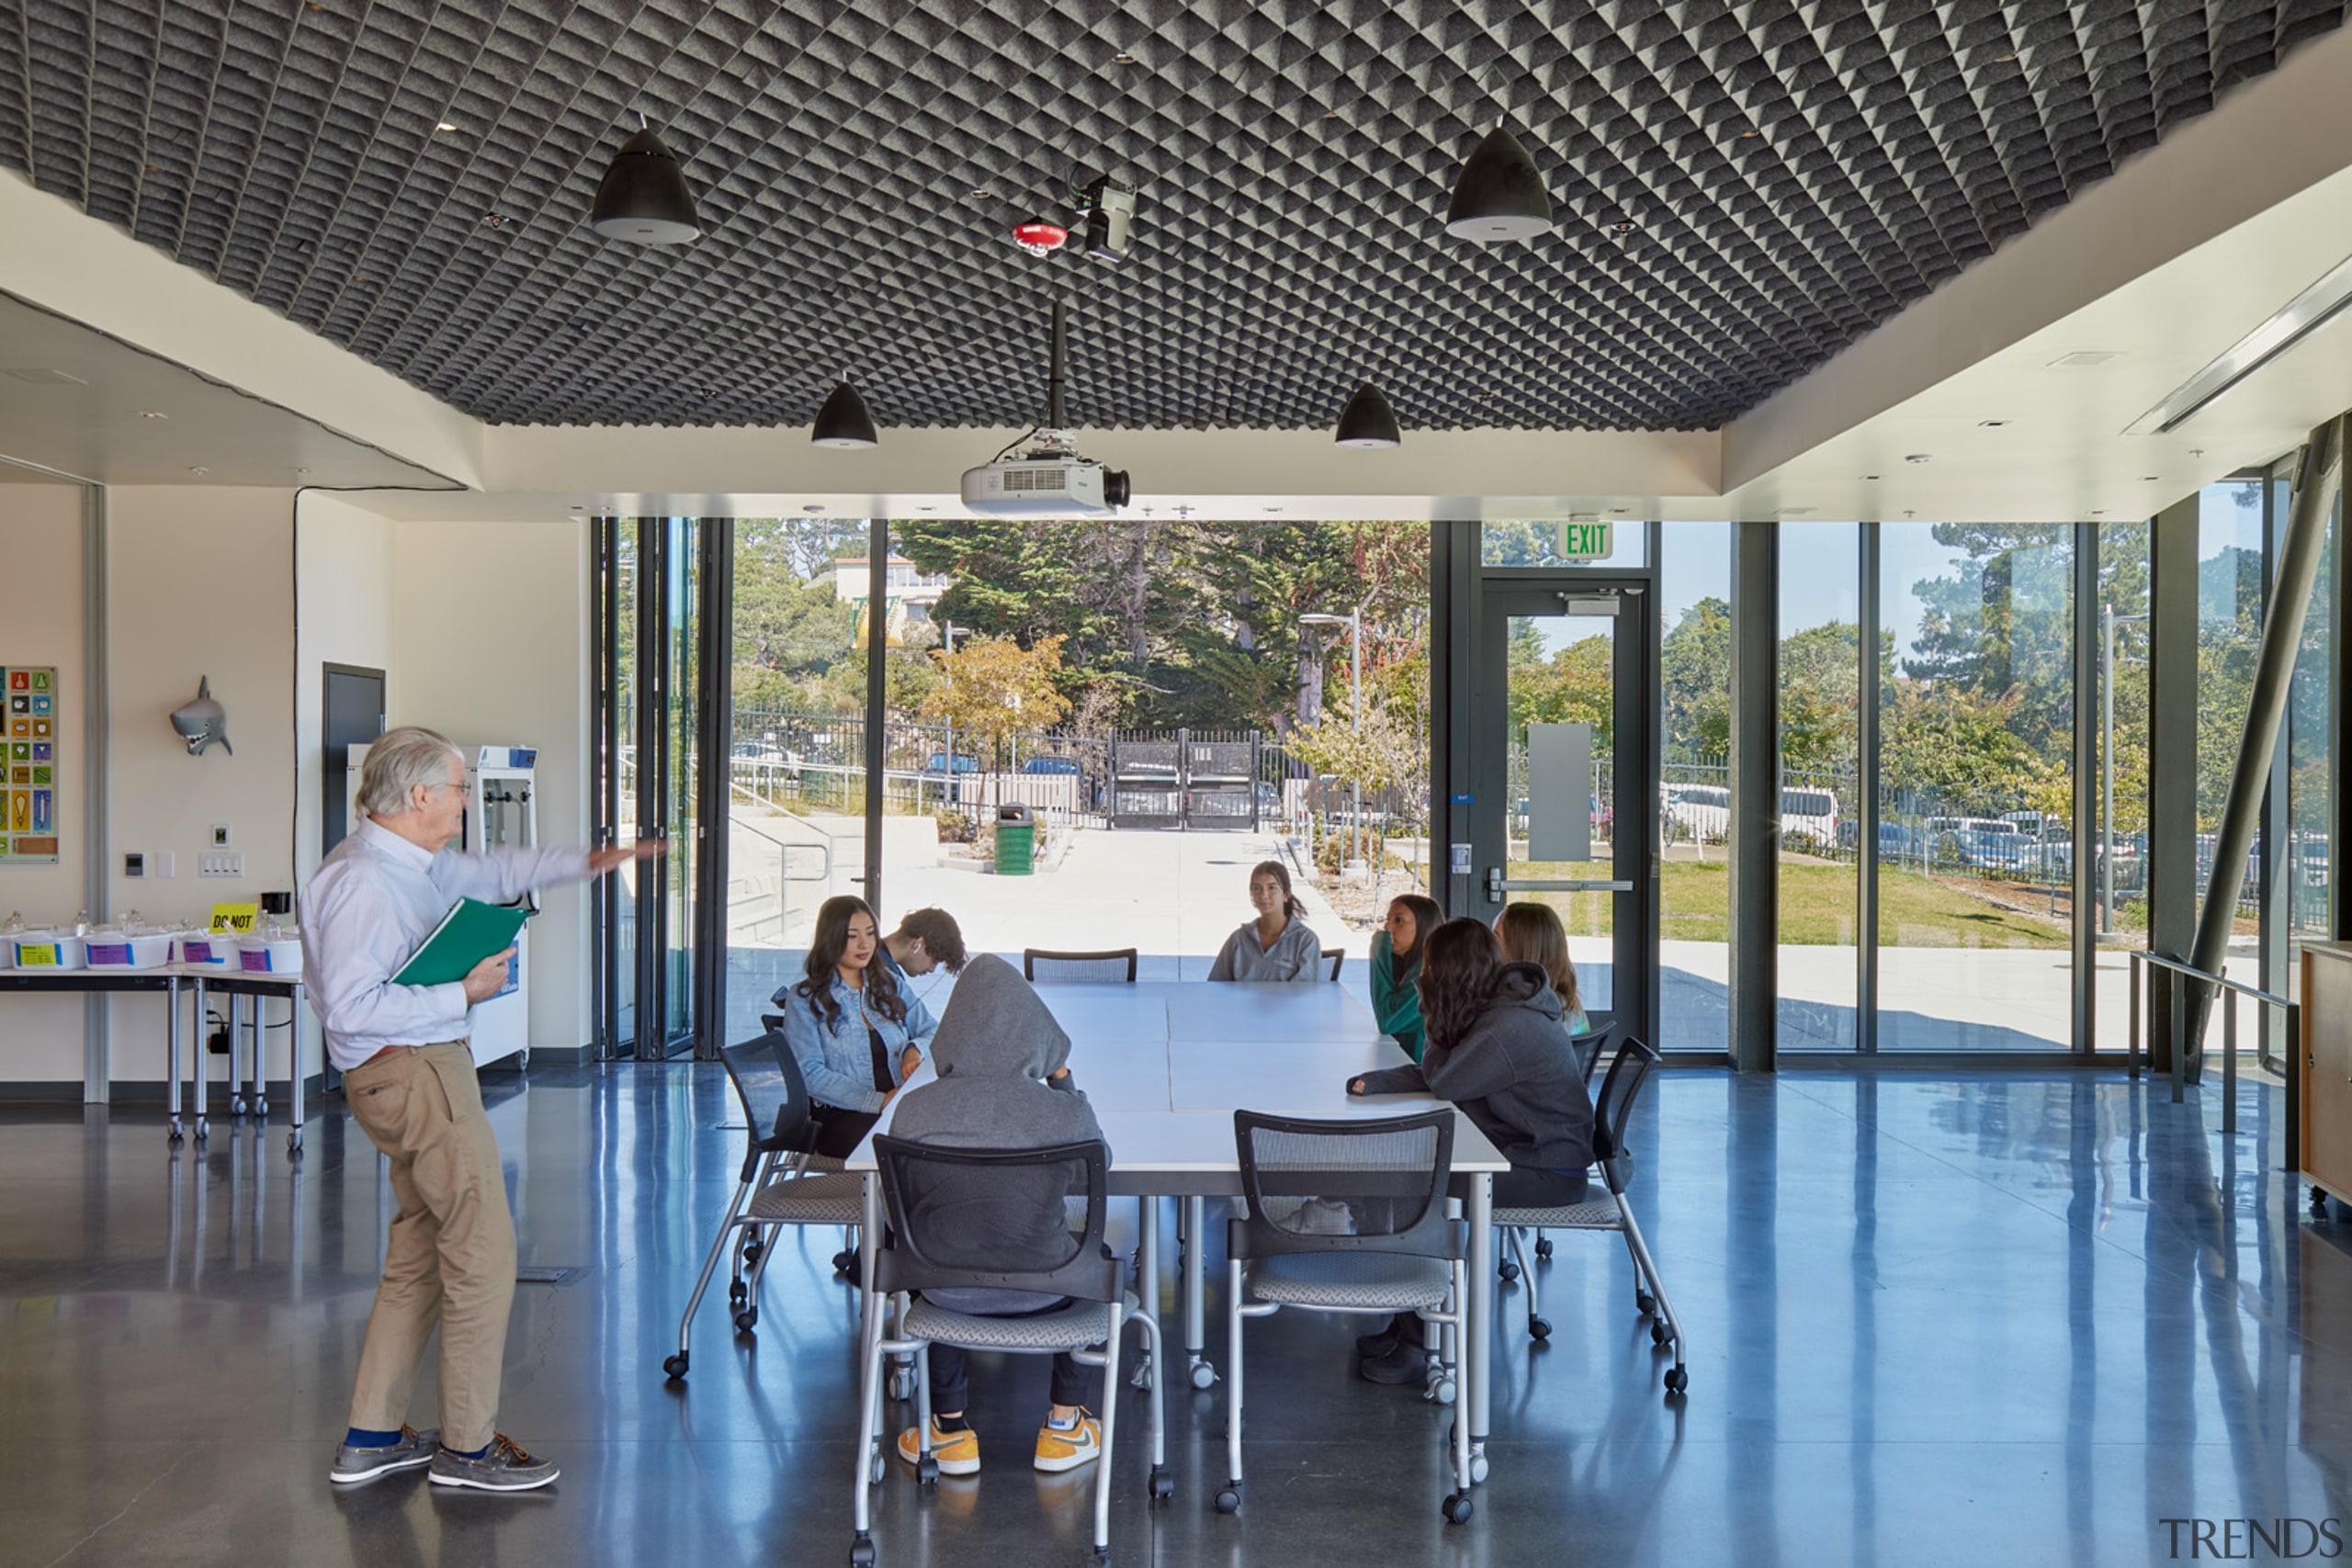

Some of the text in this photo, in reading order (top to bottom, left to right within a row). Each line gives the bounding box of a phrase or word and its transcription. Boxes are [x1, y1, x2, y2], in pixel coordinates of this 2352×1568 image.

[1567, 525, 1607, 554] EXIT
[213, 915, 253, 928] DO NOT
